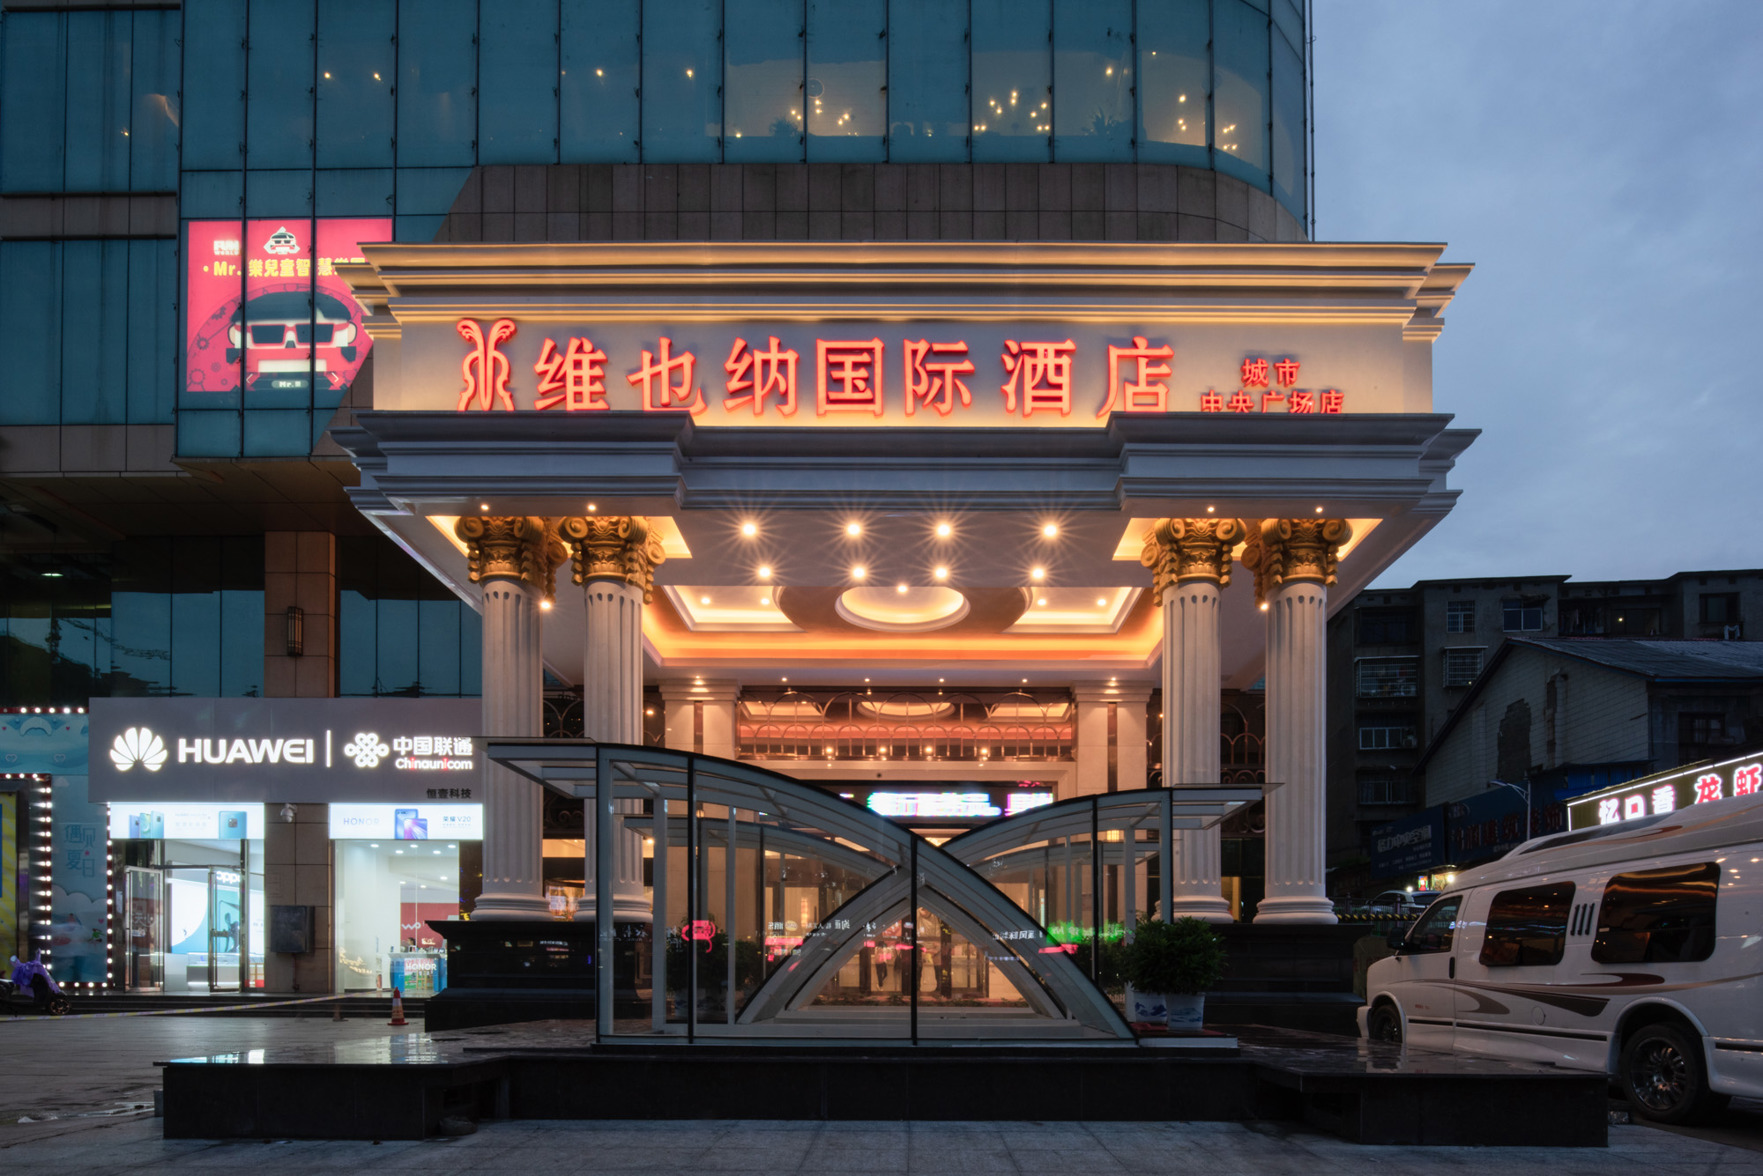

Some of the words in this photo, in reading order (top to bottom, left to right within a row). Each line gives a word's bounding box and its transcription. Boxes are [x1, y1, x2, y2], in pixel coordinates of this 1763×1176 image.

[213, 261, 242, 276] Mr.
[533, 335, 1175, 419] 维也纳国际酒店
[1240, 357, 1302, 388] 城市
[1200, 389, 1345, 414] 中央广场店
[178, 738, 314, 764] HUAWEI
[393, 736, 473, 757] 中国联通
[1694, 763, 1762, 805] 龙虾
[343, 817, 380, 826] HONOR
[456, 815, 472, 823] V20
[64, 824, 96, 848] 遇见
[65, 849, 95, 878] 夏日
[405, 963, 437, 971] HONOR
